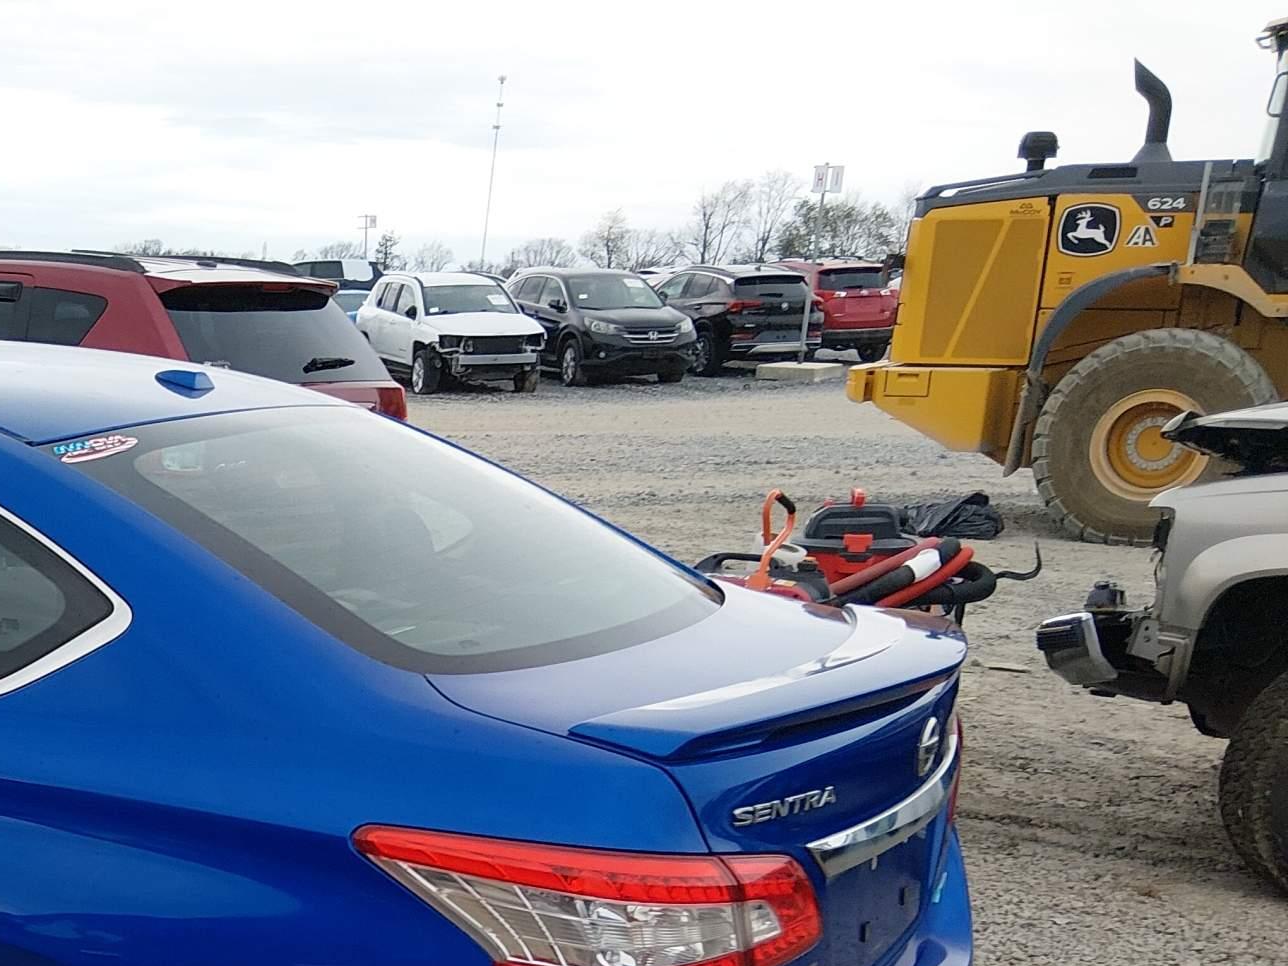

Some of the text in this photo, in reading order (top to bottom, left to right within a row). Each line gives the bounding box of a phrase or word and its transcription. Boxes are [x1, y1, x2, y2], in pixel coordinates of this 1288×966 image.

[1147, 197, 1186, 210] 624
[1159, 216, 1173, 227] P
[733, 786, 837, 827] SENTRA
